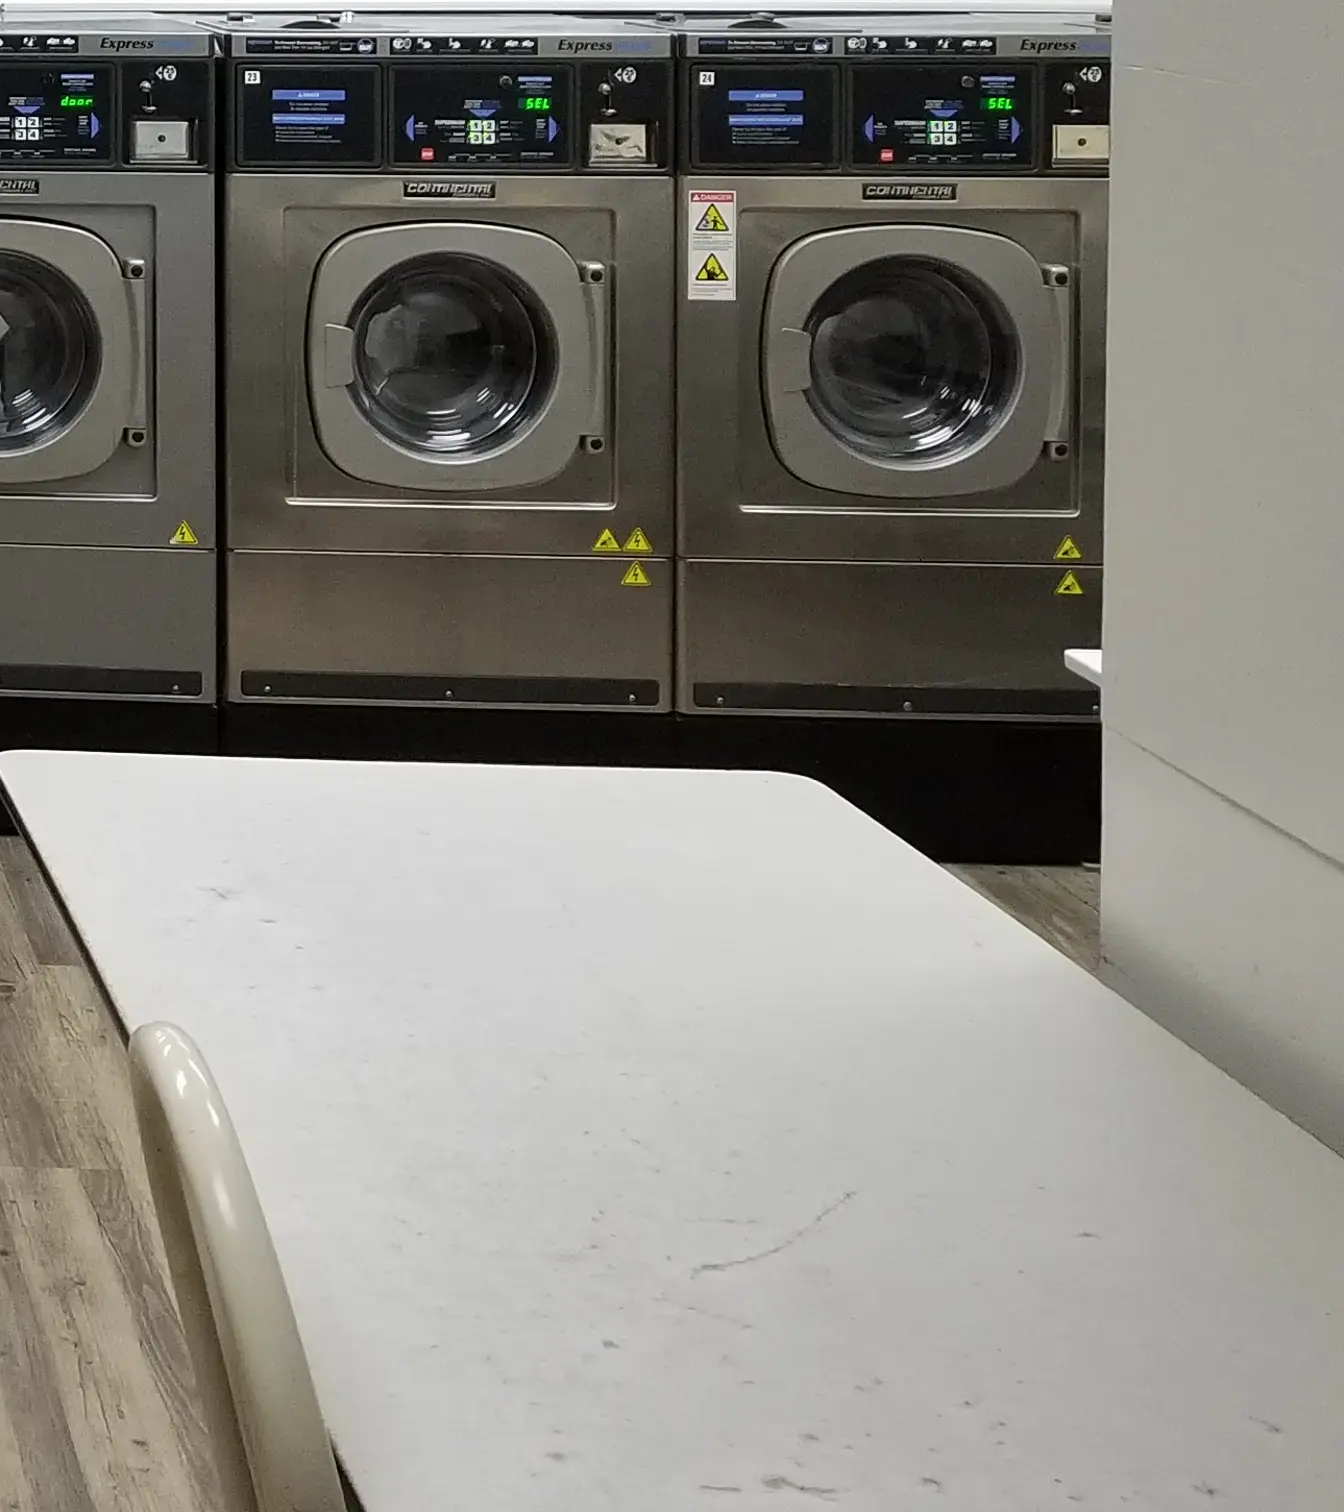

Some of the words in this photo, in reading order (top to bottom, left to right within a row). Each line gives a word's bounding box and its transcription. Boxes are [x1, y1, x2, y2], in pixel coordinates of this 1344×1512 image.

[100, 38, 154, 52] Express
[558, 39, 612, 53] Express
[1020, 39, 1076, 53] Express
[248, 73, 257, 81] 23
[702, 74, 711, 82] 24
[61, 96, 92, 106] door
[526, 98, 549, 109] SEL
[988, 98, 1012, 109] SEL
